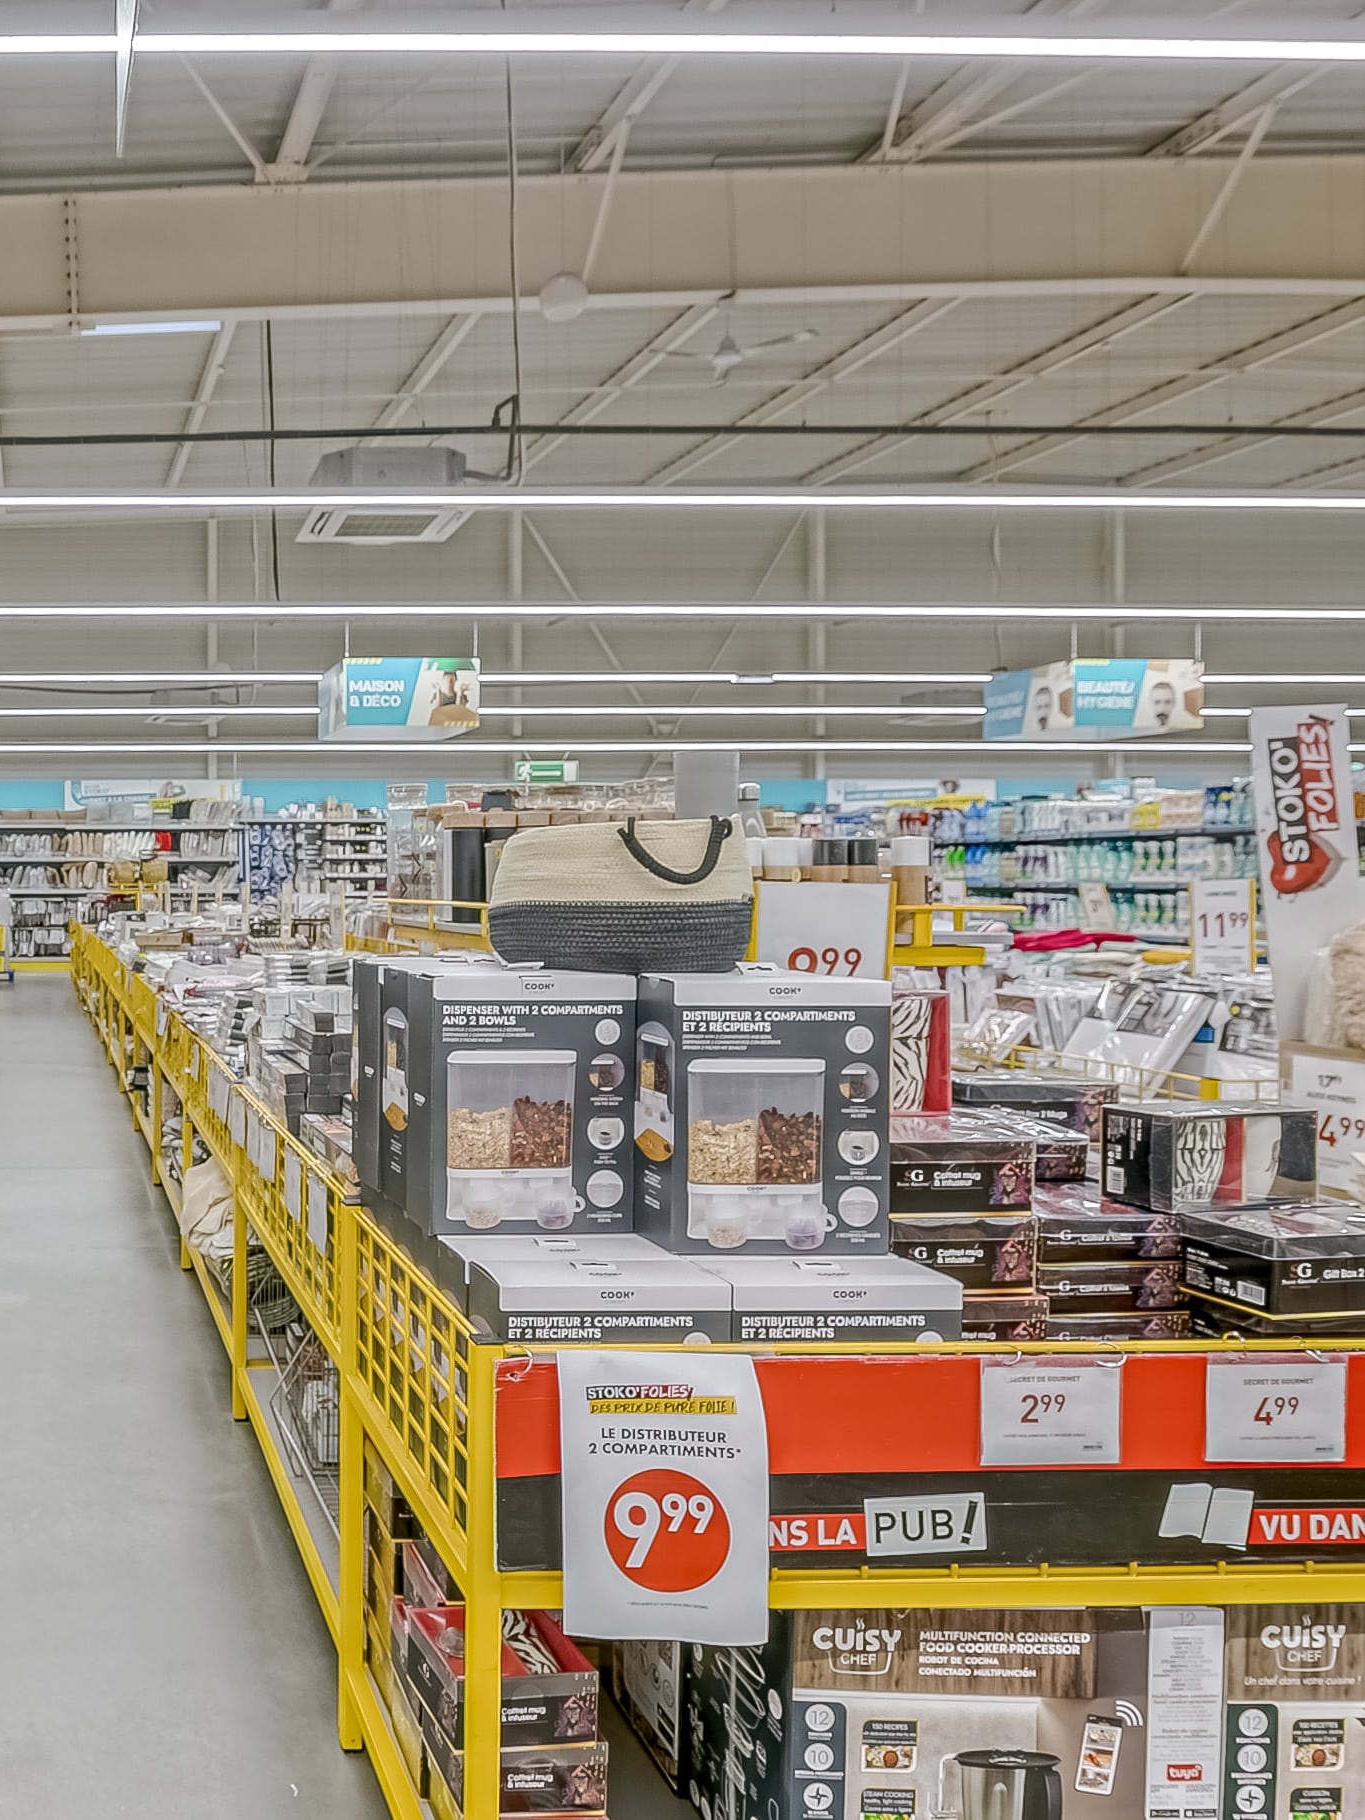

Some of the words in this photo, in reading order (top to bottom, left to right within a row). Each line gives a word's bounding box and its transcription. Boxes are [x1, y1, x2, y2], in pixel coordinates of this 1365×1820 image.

[349, 680, 404, 692] MAISON
[349, 696, 359, 707] &
[363, 692, 401, 708] DÉCO
[442, 1004, 500, 1015] DISPENSER
[502, 1004, 529, 1015] WITH
[531, 1006, 539, 1015] 2
[541, 1004, 623, 1015] COMPARTMENTS
[443, 1016, 468, 1026] AND
[469, 1016, 477, 1026] 2
[479, 1016, 517, 1026] BOWLS
[682, 1010, 752, 1022] DISTIBUTEUR
[753, 1011, 762, 1021] 2
[763, 1010, 856, 1022] COMPARTIMENTS
[683, 1022, 698, 1032] ET
[699, 1022, 707, 1032] 2
[709, 1020, 771, 1032] RÉCIPIENTS
[508, 1316, 581, 1328] DISTIBUTEUR
[584, 1316, 592, 1327] 2
[594, 1316, 693, 1327] COMPARTIMENTS
[741, 1316, 814, 1327] DISTIBUTEUR
[817, 1316, 825, 1326] 2
[827, 1316, 926, 1326] COMPARTIMENTS
[508, 1328, 522, 1339] ET
[525, 1328, 533, 1339] 2
[535, 1326, 602, 1339] RÉCIPIENTS
[741, 1328, 757, 1338] ET
[758, 1328, 767, 1338] 2
[769, 1326, 835, 1338] RÉCIPIENTS
[591, 1403, 611, 1414] DES
[614, 1402, 643, 1414] PRIX
[645, 1402, 661, 1412] DE
[663, 1401, 695, 1414] PURE
[699, 1400, 729, 1413] FOLIE
[601, 1428, 616, 1438] LE
[621, 1428, 727, 1443] DISTRIBUTEUR
[589, 1443, 598, 1454] 2
[817, 1518, 857, 1546] LA
[1259, 1514, 1301, 1541] VU
[1309, 1514, 1365, 1540] DAN
[919, 1631, 1014, 1644] MULTIFUNCTION
[1017, 1632, 1091, 1644] CONNECTED
[919, 1642, 955, 1654] FOOD
[956, 1643, 1081, 1656] COOKER-PROCESSOR
[839, 1654, 877, 1666] CHEF
[919, 1656, 948, 1666] ROBOT
[951, 1656, 963, 1665] DE
[964, 1656, 999, 1666] COCINA
[919, 1667, 971, 1678] CONECTADO
[973, 1666, 1037, 1678] MULTIFUNCIÓN
[529, 1707, 546, 1715] mug
[811, 1710, 829, 1726] 12
[811, 1750, 829, 1764] 10
[535, 1774, 553, 1782] mug
[1169, 1767, 1201, 1780] tuya
